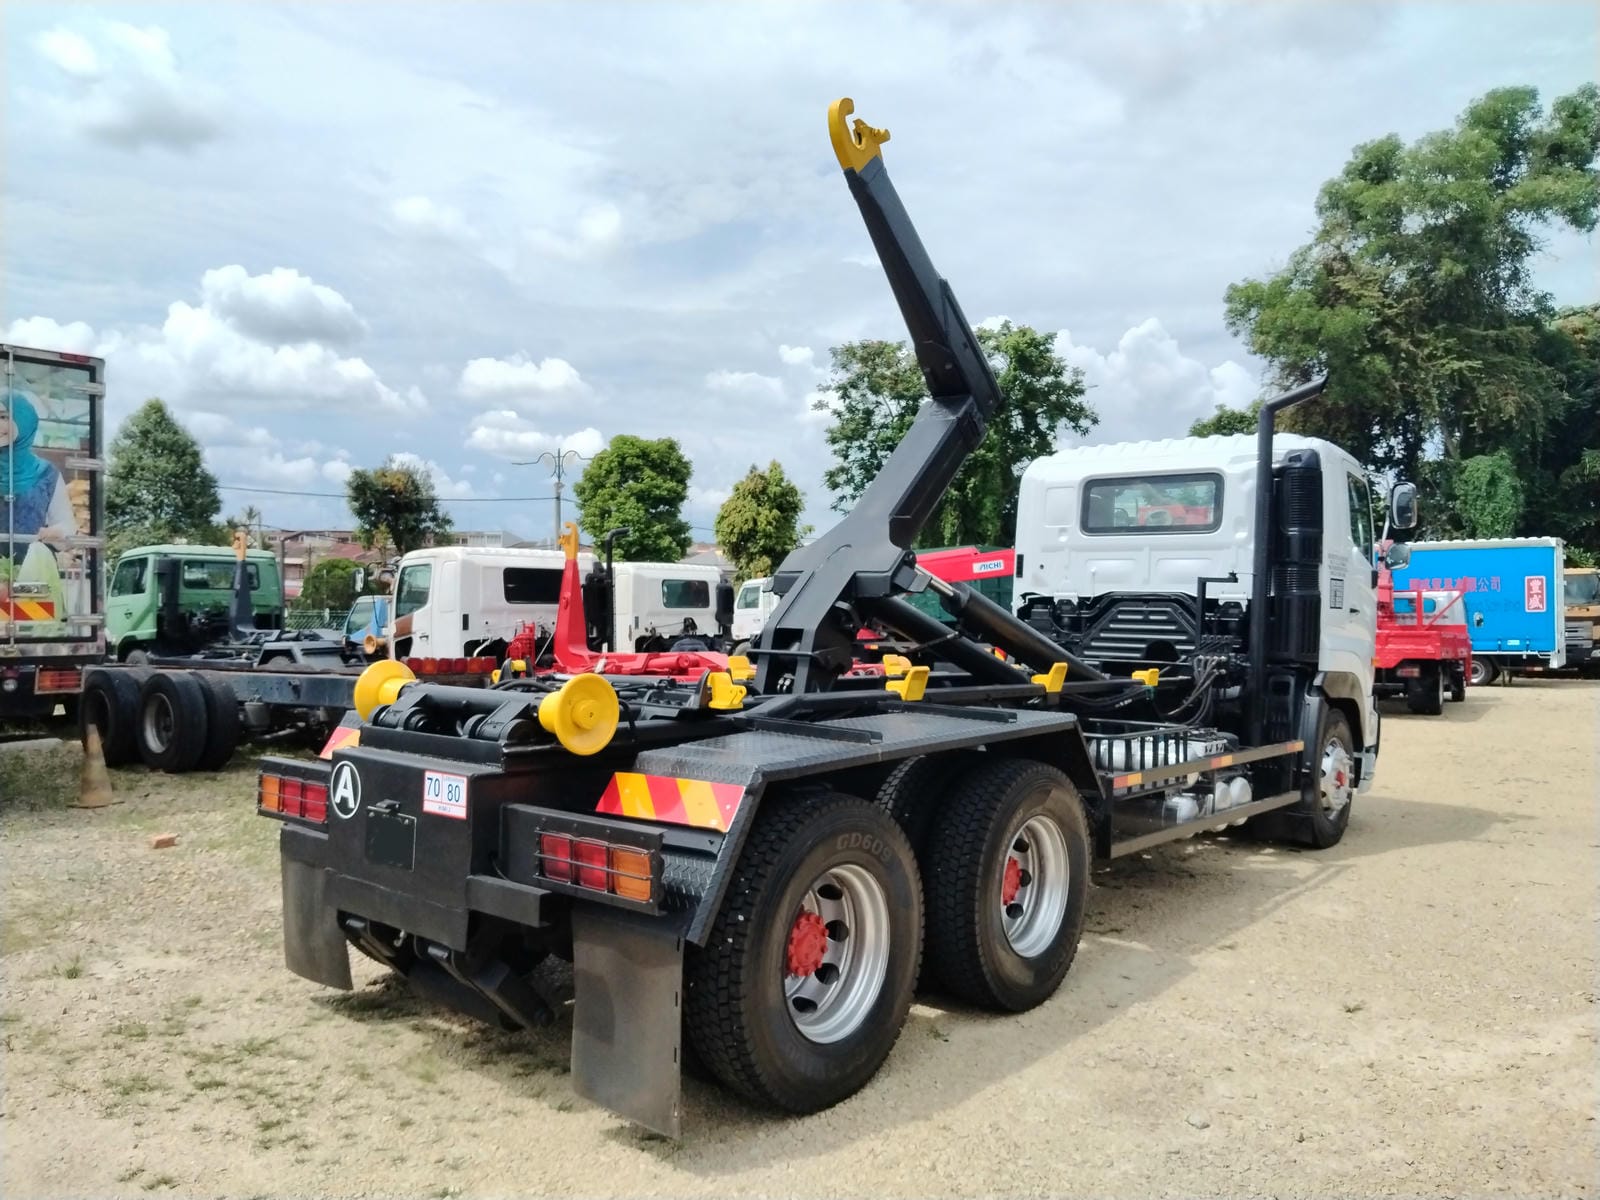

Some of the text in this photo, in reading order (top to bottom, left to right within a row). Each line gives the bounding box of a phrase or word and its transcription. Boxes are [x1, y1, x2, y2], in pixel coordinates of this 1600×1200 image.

[334, 765, 355, 809] A
[426, 777, 440, 797] 70
[447, 784, 460, 803] 80
